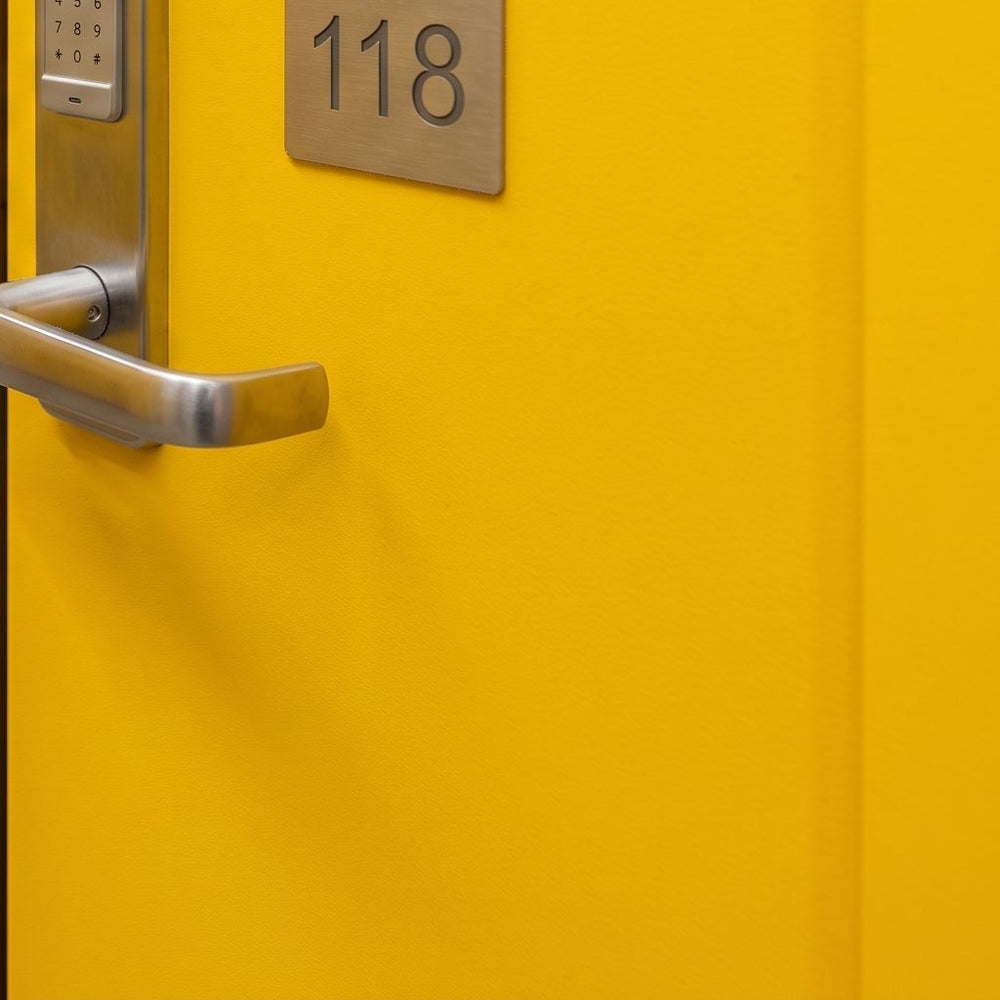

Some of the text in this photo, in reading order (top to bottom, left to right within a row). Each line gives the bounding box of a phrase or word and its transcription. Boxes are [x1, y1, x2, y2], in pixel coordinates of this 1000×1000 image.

[55, 20, 101, 37] 7 8 9
[73, 50, 81, 63] 0
[314, 14, 465, 127] 118
